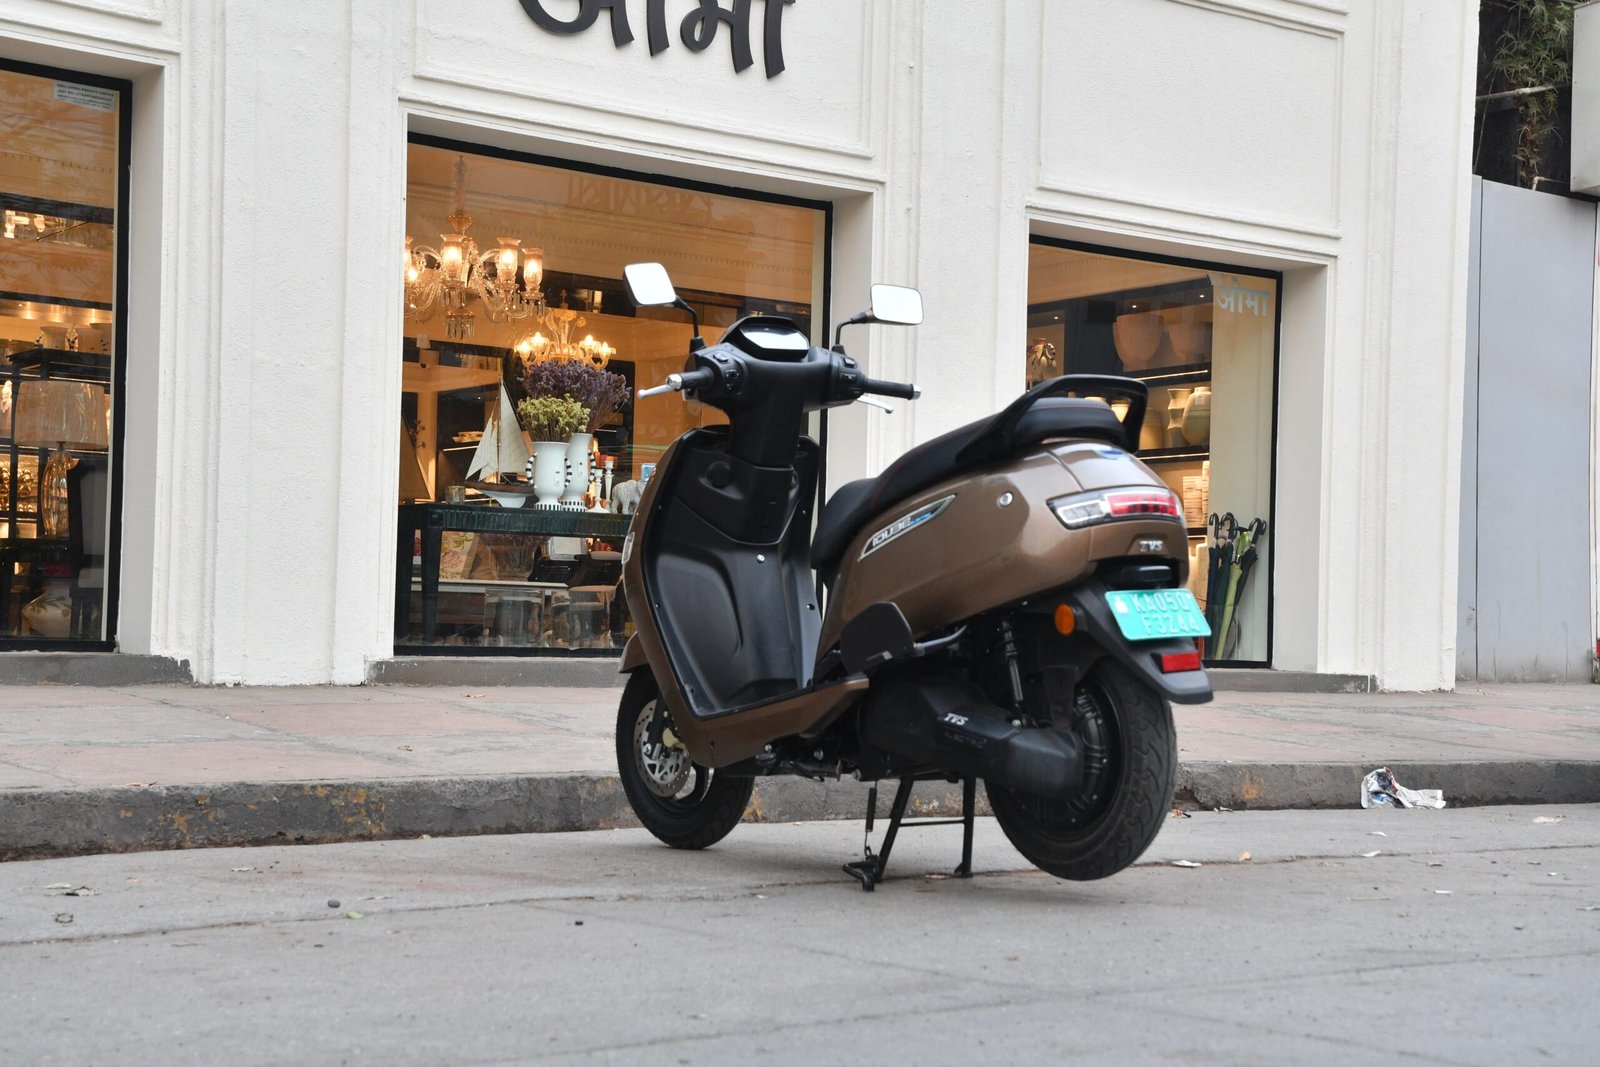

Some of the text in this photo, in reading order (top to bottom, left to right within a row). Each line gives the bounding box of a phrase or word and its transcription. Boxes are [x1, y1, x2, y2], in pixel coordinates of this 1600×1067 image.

[1139, 540, 1163, 551] TVS
[1142, 613, 1200, 635] F3244
[944, 713, 968, 725] TVS
